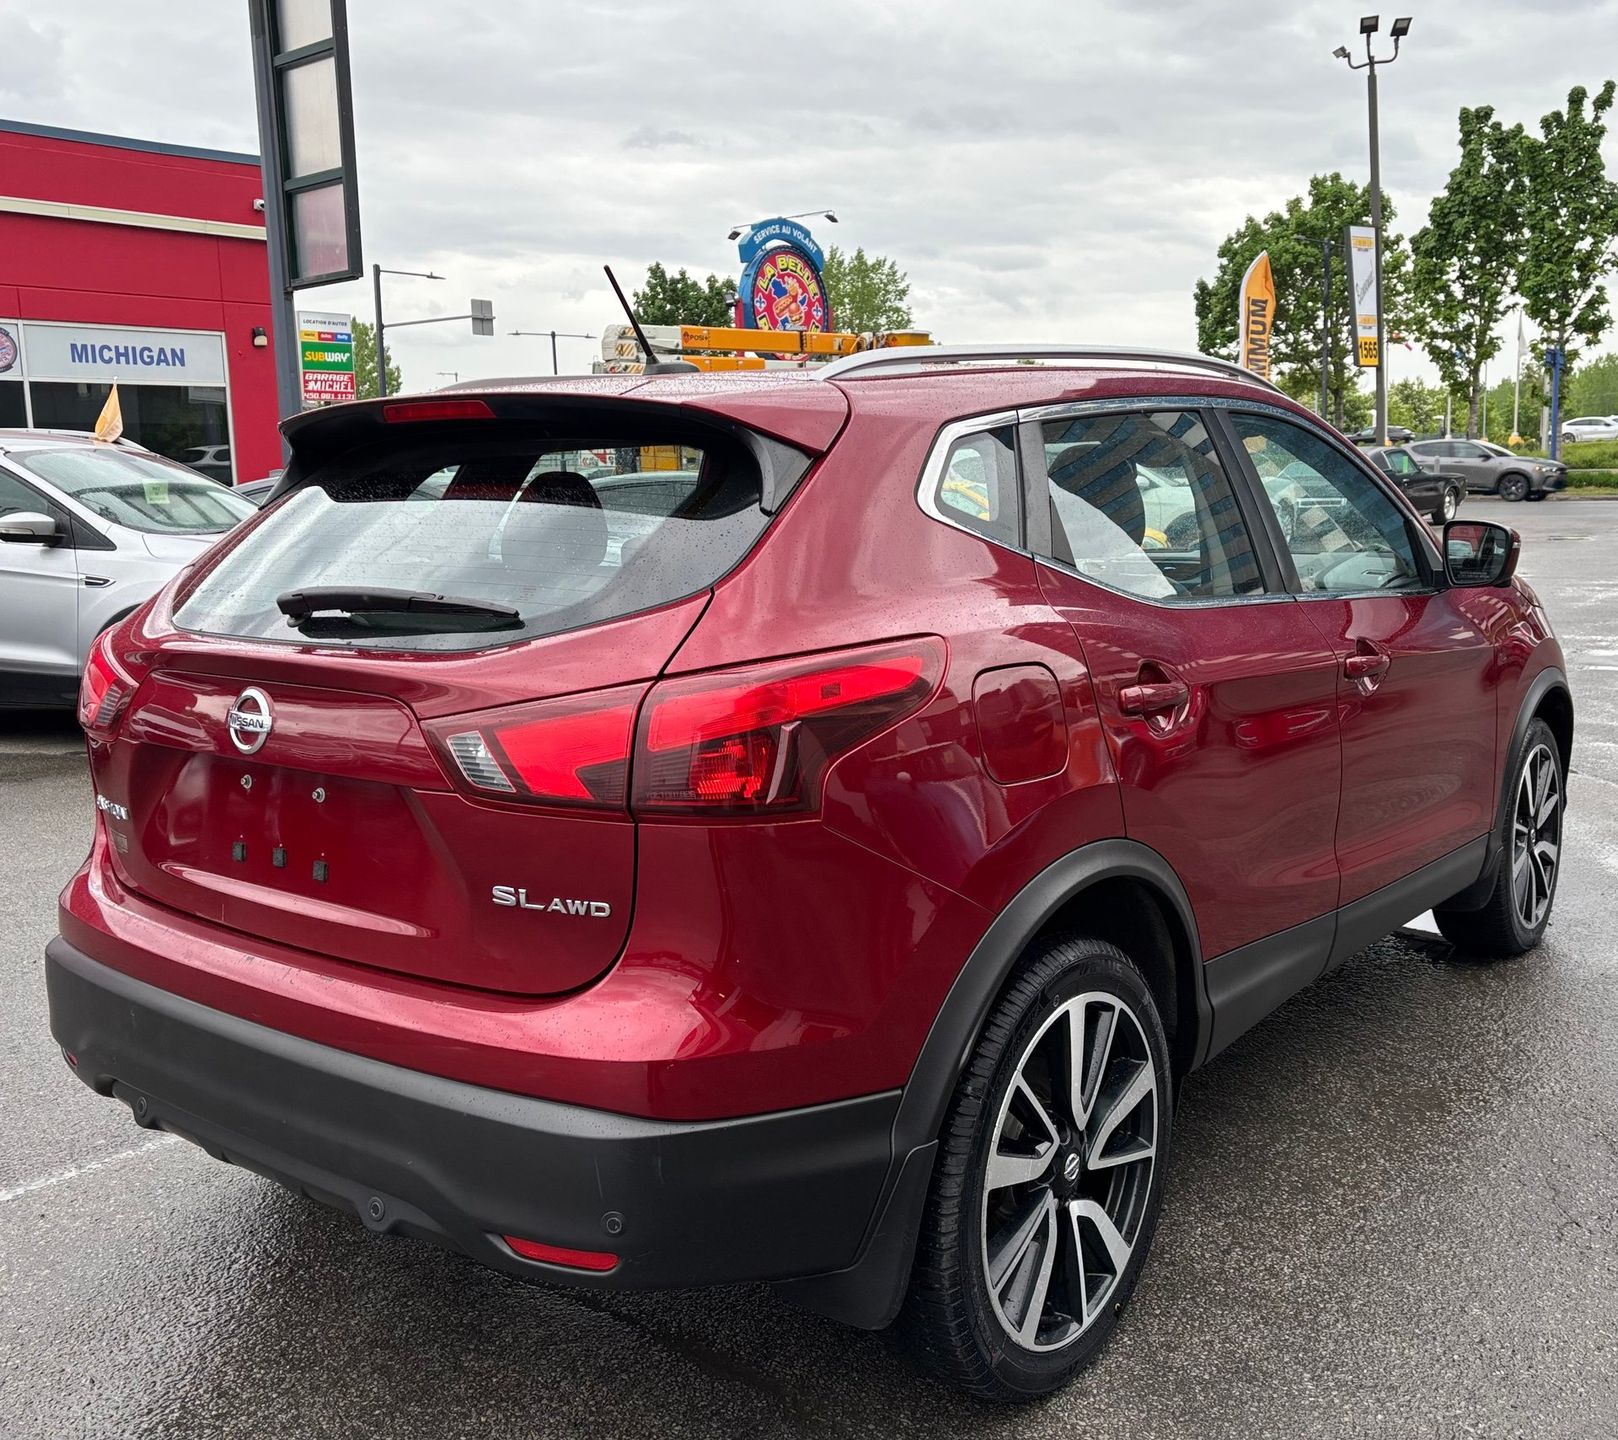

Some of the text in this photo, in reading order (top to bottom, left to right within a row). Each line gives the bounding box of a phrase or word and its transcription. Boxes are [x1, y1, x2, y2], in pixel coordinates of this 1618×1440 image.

[753, 224, 818, 253] SERVICE AU VOLANT
[757, 255, 820, 301] LA BELLE
[70, 343, 186, 367] MICHIGAN
[304, 351, 350, 362] SUBWAY
[1359, 341, 1378, 359] 1565
[305, 373, 352, 382] GARAGE
[309, 381, 354, 392] MICHEL
[492, 885, 611, 918] SL AWD
